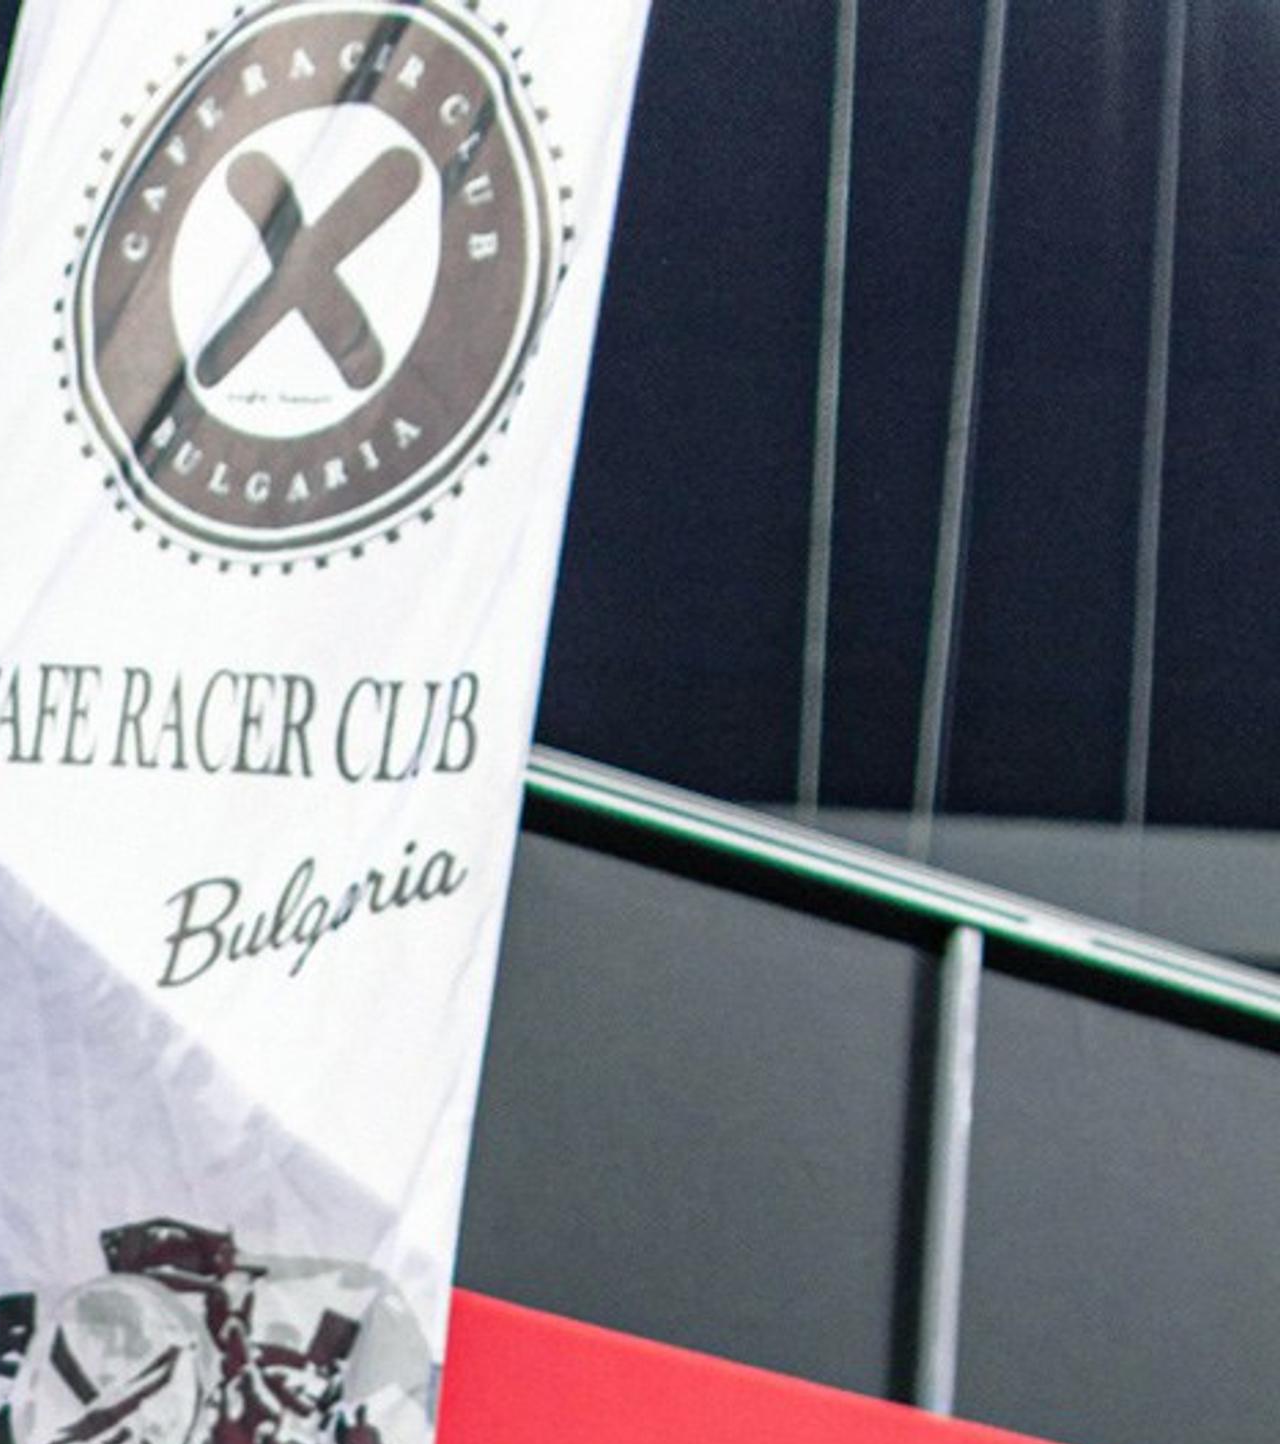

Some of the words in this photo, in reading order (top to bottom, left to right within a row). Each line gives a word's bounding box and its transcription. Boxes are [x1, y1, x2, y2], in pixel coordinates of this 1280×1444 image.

[121, 97, 224, 262] CAFE
[241, 40, 426, 95] RACER
[439, 92, 499, 261] CLUB
[151, 415, 423, 505] BULGARIA
[109, 665, 318, 777] RACER
[156, 840, 469, 988] Bulgaria
